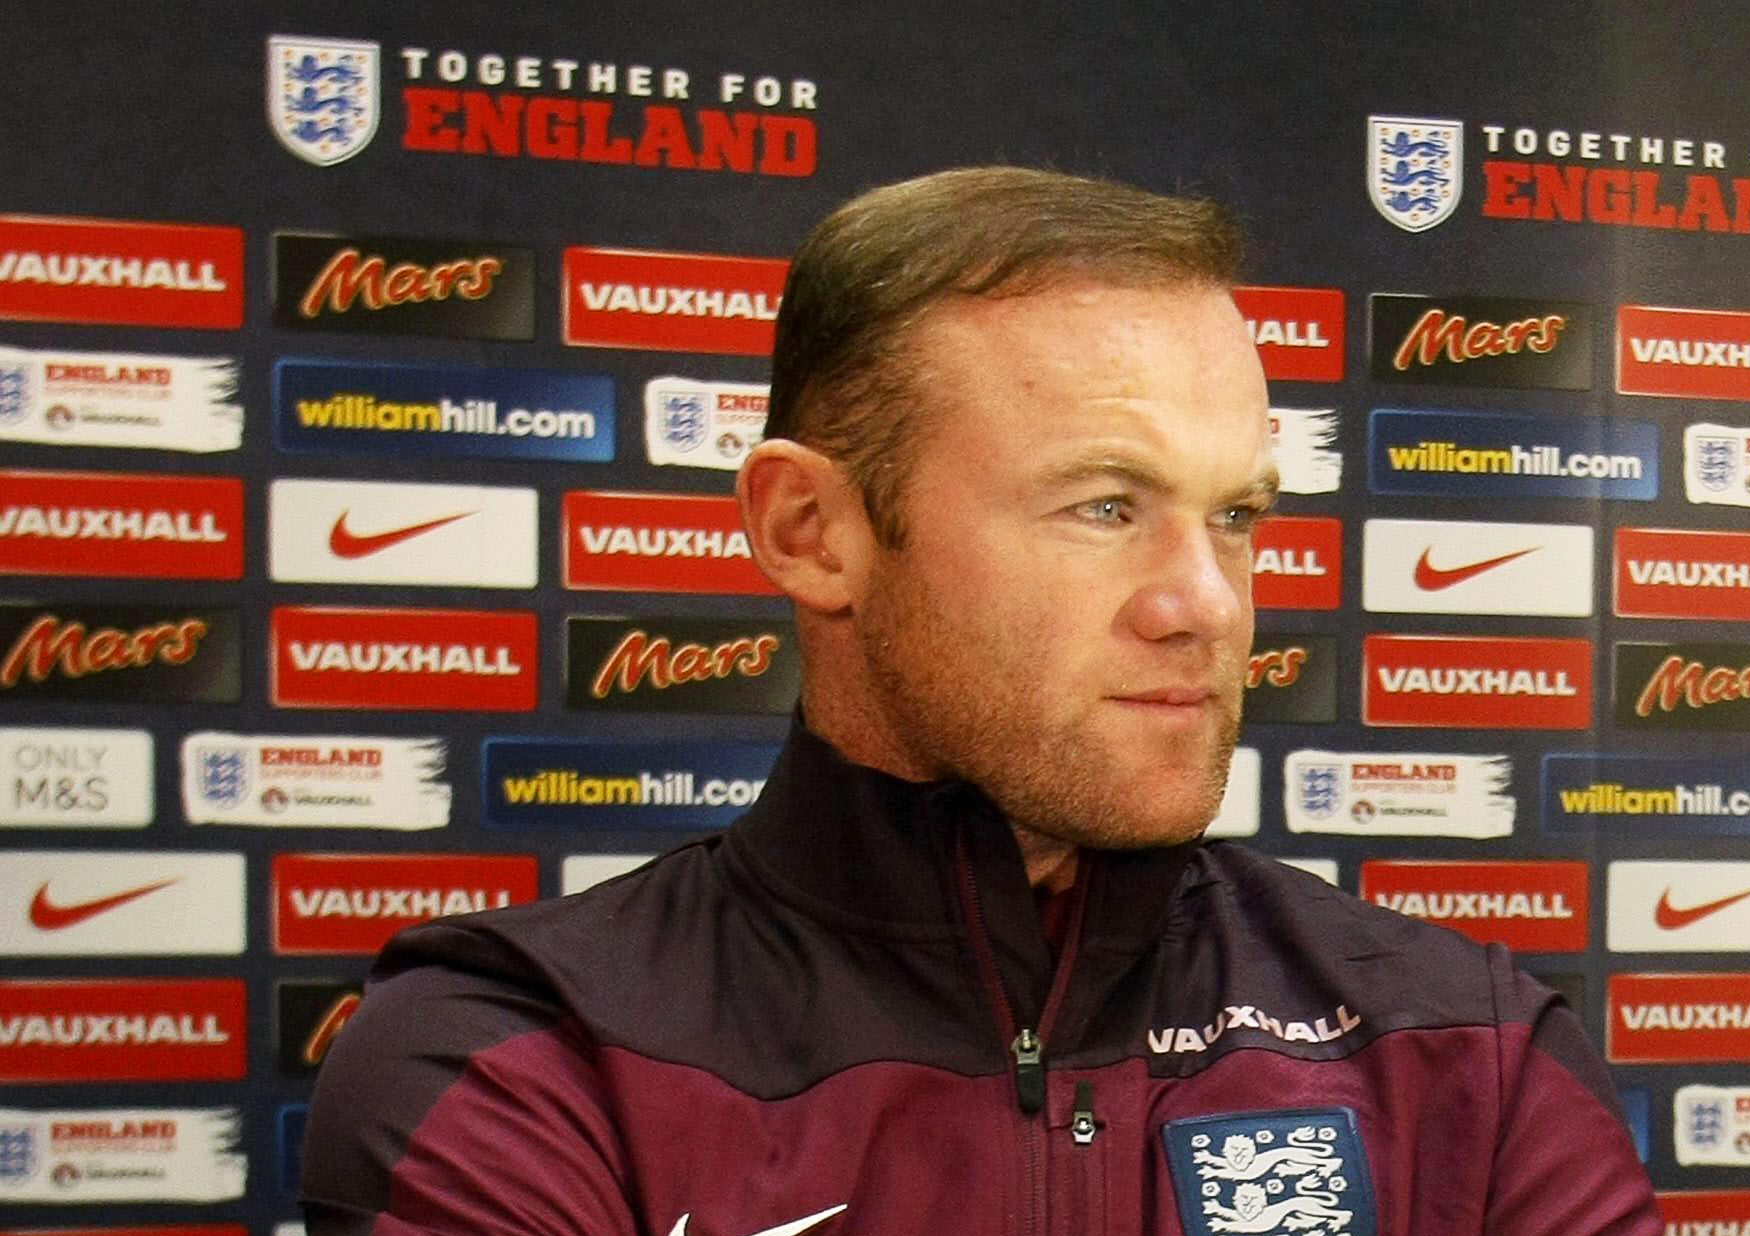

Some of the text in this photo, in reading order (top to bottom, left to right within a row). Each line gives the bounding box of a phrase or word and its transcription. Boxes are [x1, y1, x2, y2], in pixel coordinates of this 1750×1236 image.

[404, 47, 818, 110] TOGETHER FOR
[402, 88, 817, 177] ENGLAND
[1483, 126, 1726, 169] TOGETHER
[300, 247, 503, 317] Mars
[581, 283, 779, 320] VAUXHAL
[1393, 308, 1565, 372] Mars
[297, 393, 595, 440] williamhill.com
[1388, 443, 1642, 480] williamhill.com
[582, 525, 750, 559] VAUXHA
[2, 616, 206, 687] Mars
[292, 645, 520, 677] VAUXHALL
[592, 630, 781, 698] Mars
[1379, 667, 1576, 697] VAUXHALL
[13, 744, 107, 772] ONLY
[261, 748, 382, 767] ENGLAND
[1352, 764, 1456, 780] ENGLAND
[14, 778, 110, 812] M&S
[1149, 1005, 1361, 1053] VAUXHALL
